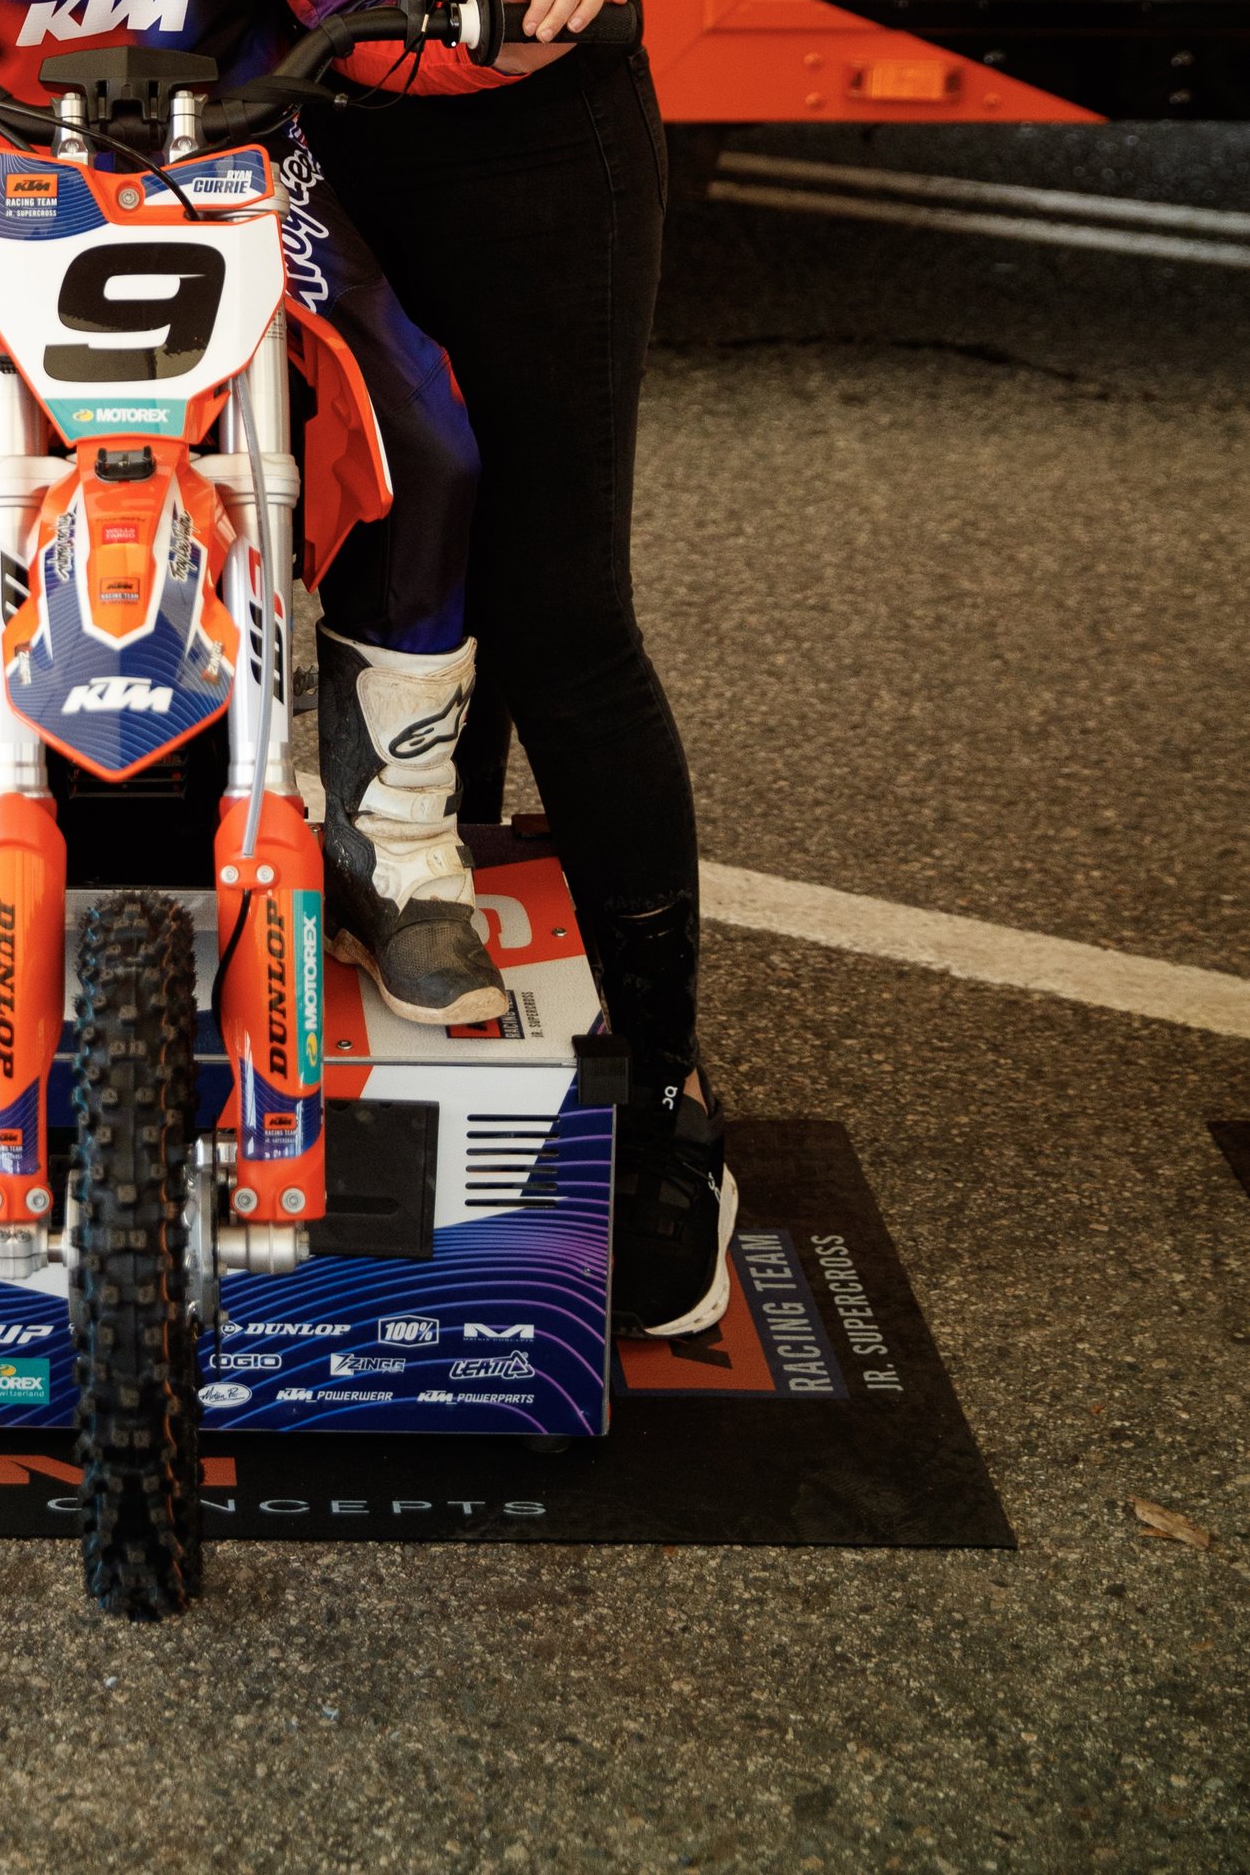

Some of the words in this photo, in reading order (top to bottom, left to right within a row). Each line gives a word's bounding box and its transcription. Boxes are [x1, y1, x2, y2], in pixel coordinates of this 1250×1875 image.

[226, 169, 253, 180] RYAN
[12, 178, 52, 192] KTM
[192, 178, 250, 194] CURRIE
[5, 198, 35, 207] RACING
[37, 197, 58, 207] TEAM
[17, 209, 58, 218] SUPERCROSS
[42, 240, 228, 384] 9
[96, 408, 170, 423] MOTOREX
[60, 675, 174, 715] KTM
[303, 915, 318, 1030] MOTOREX
[267, 898, 288, 1080] DUNLOP
[521, 991, 541, 1028] SUPERCROSS
[738, 1233, 796, 1293] TEAM
[810, 1234, 889, 1356] SUPERCROSS
[244, 1322, 352, 1336] DUNLOP
[385, 1321, 435, 1341] 100%
[762, 1301, 834, 1393] RACING
[210, 1353, 283, 1370] OGIO
[346, 1356, 406, 1372] ZINGG
[866, 1358, 904, 1392] JR.
[48, 1497, 547, 1516] CNCEPTS
